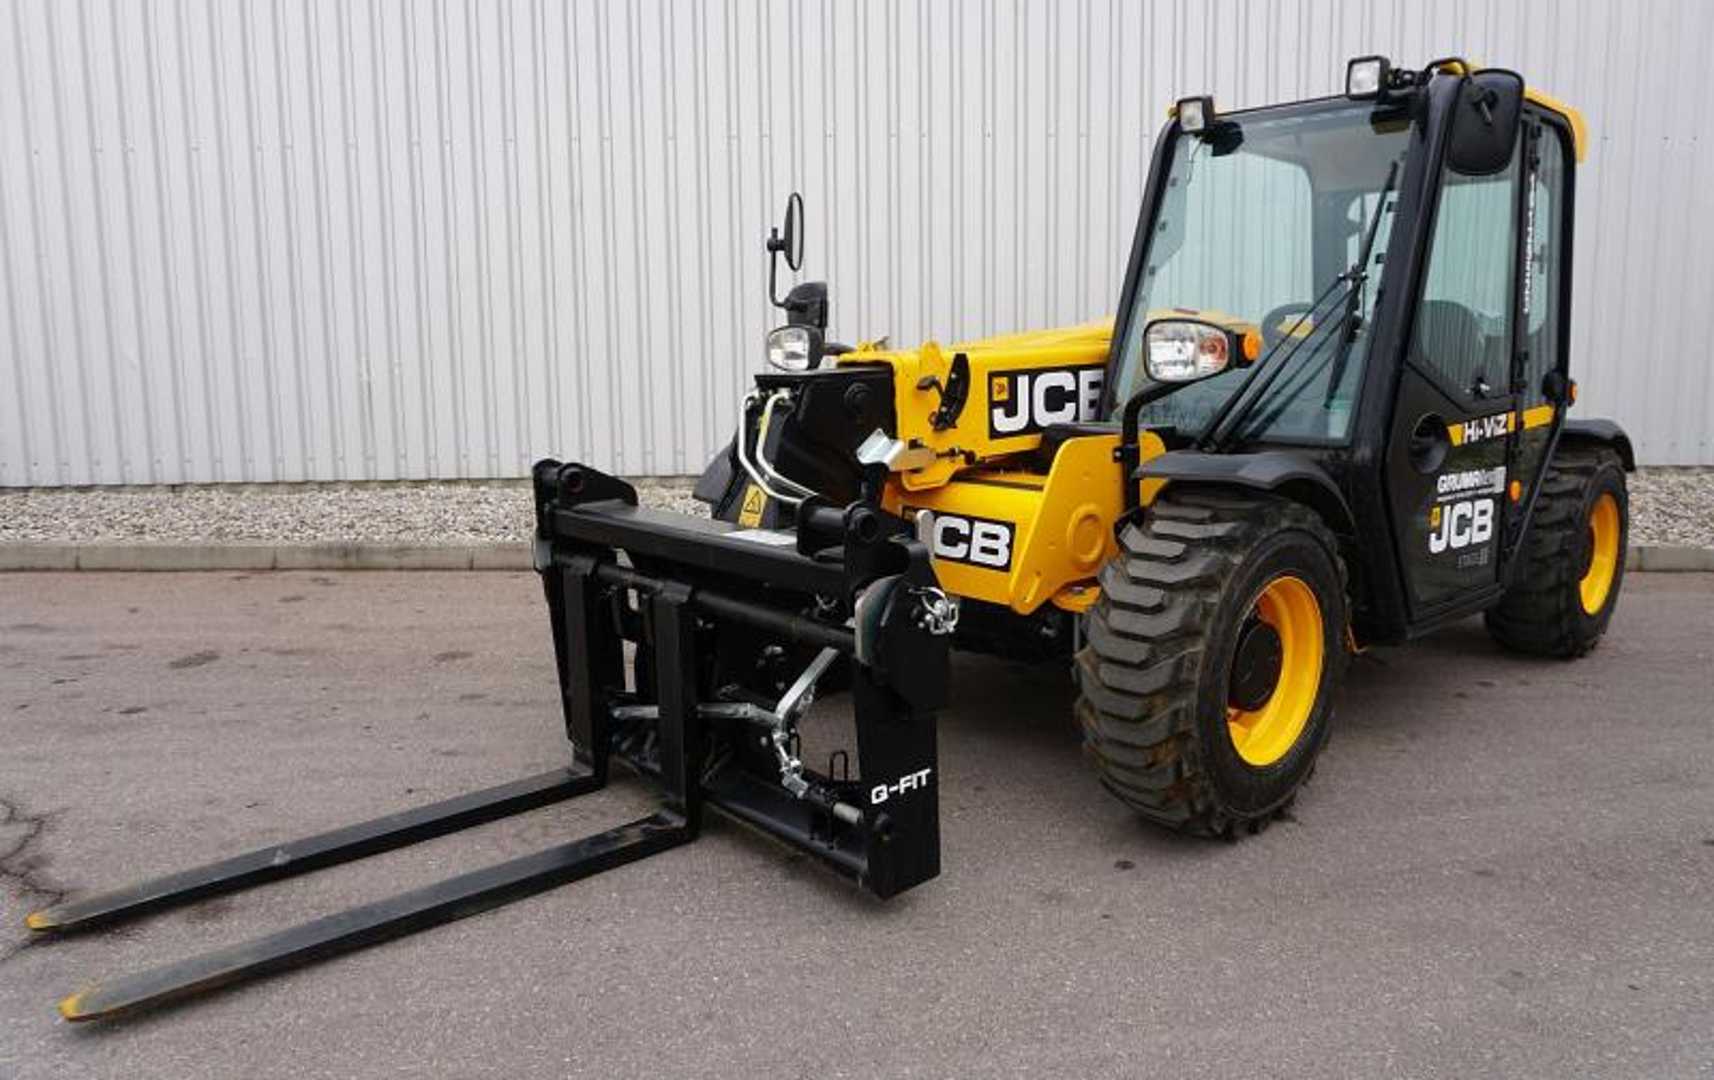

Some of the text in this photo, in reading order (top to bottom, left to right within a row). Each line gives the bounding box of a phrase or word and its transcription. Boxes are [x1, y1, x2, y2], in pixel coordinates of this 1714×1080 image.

[933, 516, 1010, 567] CB
[1429, 499, 1493, 554] JCB
[870, 768, 931, 804] G-FIT
